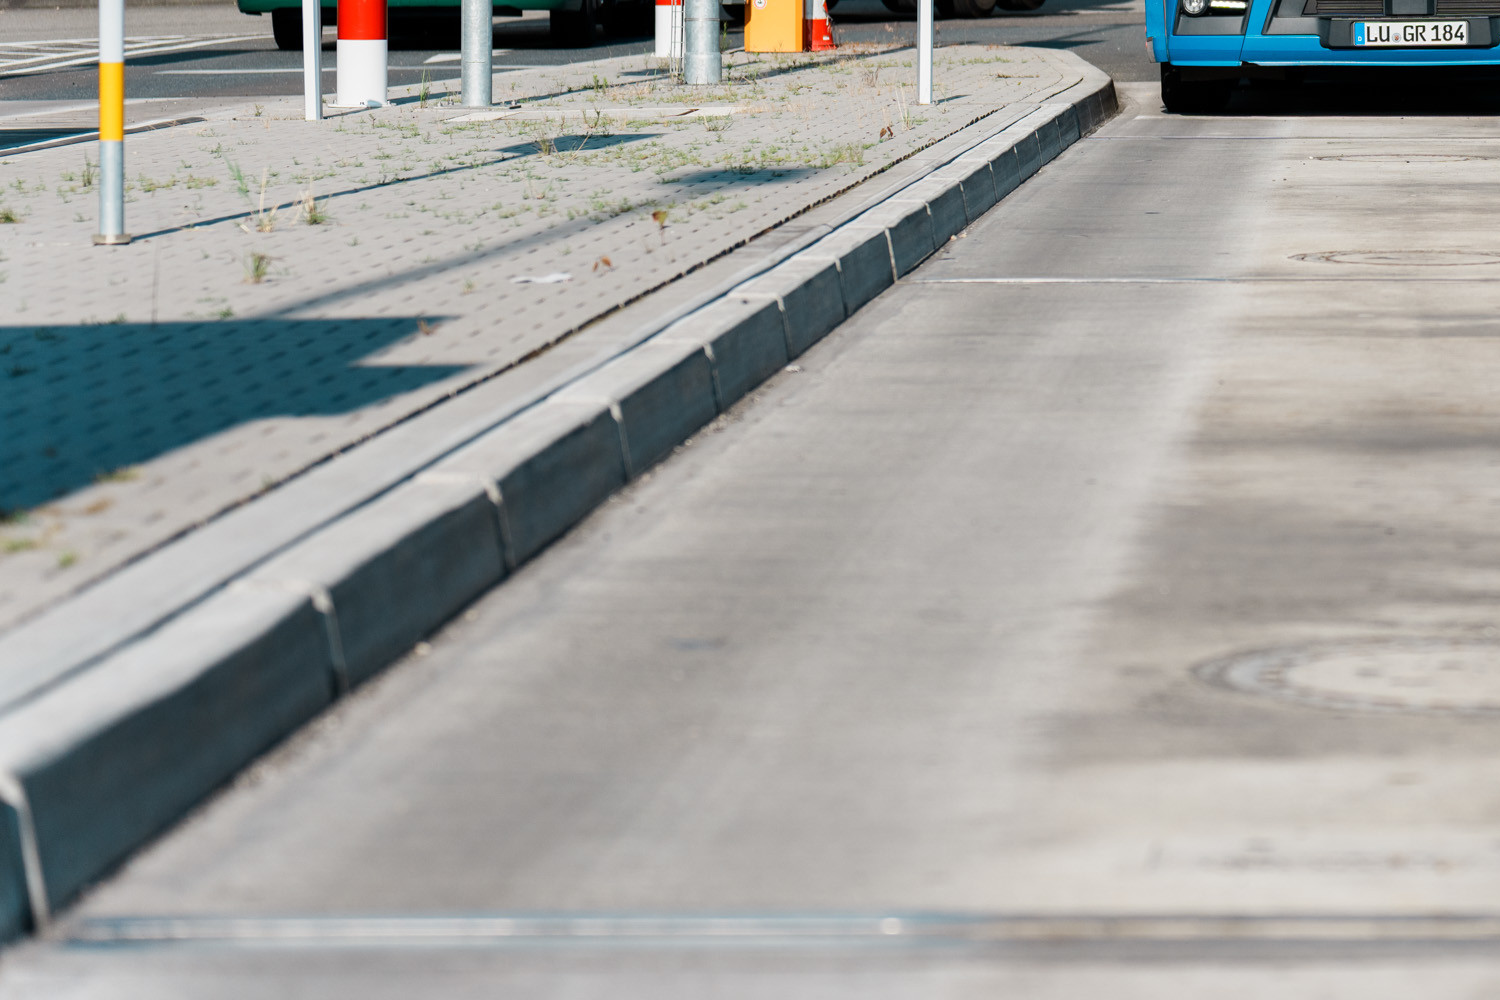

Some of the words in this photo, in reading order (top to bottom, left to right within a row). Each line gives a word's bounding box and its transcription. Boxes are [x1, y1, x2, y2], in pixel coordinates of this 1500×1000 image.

[1366, 26, 1390, 42] LU
[1403, 25, 1426, 42] GR
[1431, 24, 1465, 41] 184
